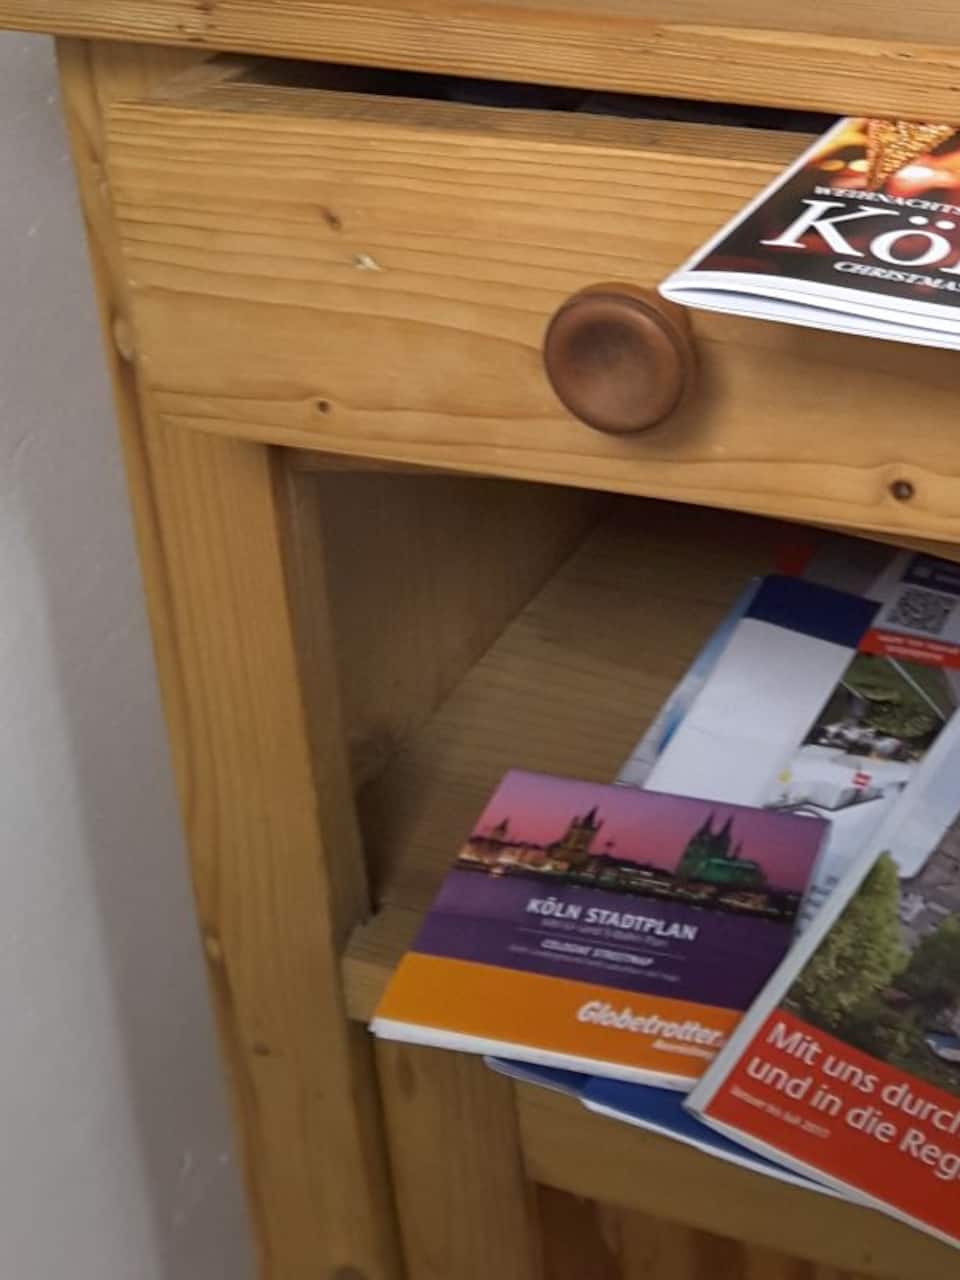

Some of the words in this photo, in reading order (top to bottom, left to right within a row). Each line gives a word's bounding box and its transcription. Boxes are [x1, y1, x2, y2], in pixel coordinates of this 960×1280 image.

[526, 895, 583, 920] KÖLN
[584, 906, 700, 942] STADTPLAN
[766, 1021, 822, 1066] Mit
[821, 1054, 880, 1094] uns
[746, 1056, 814, 1101] und
[808, 1083, 844, 1117] in
[845, 1106, 897, 1144] die
